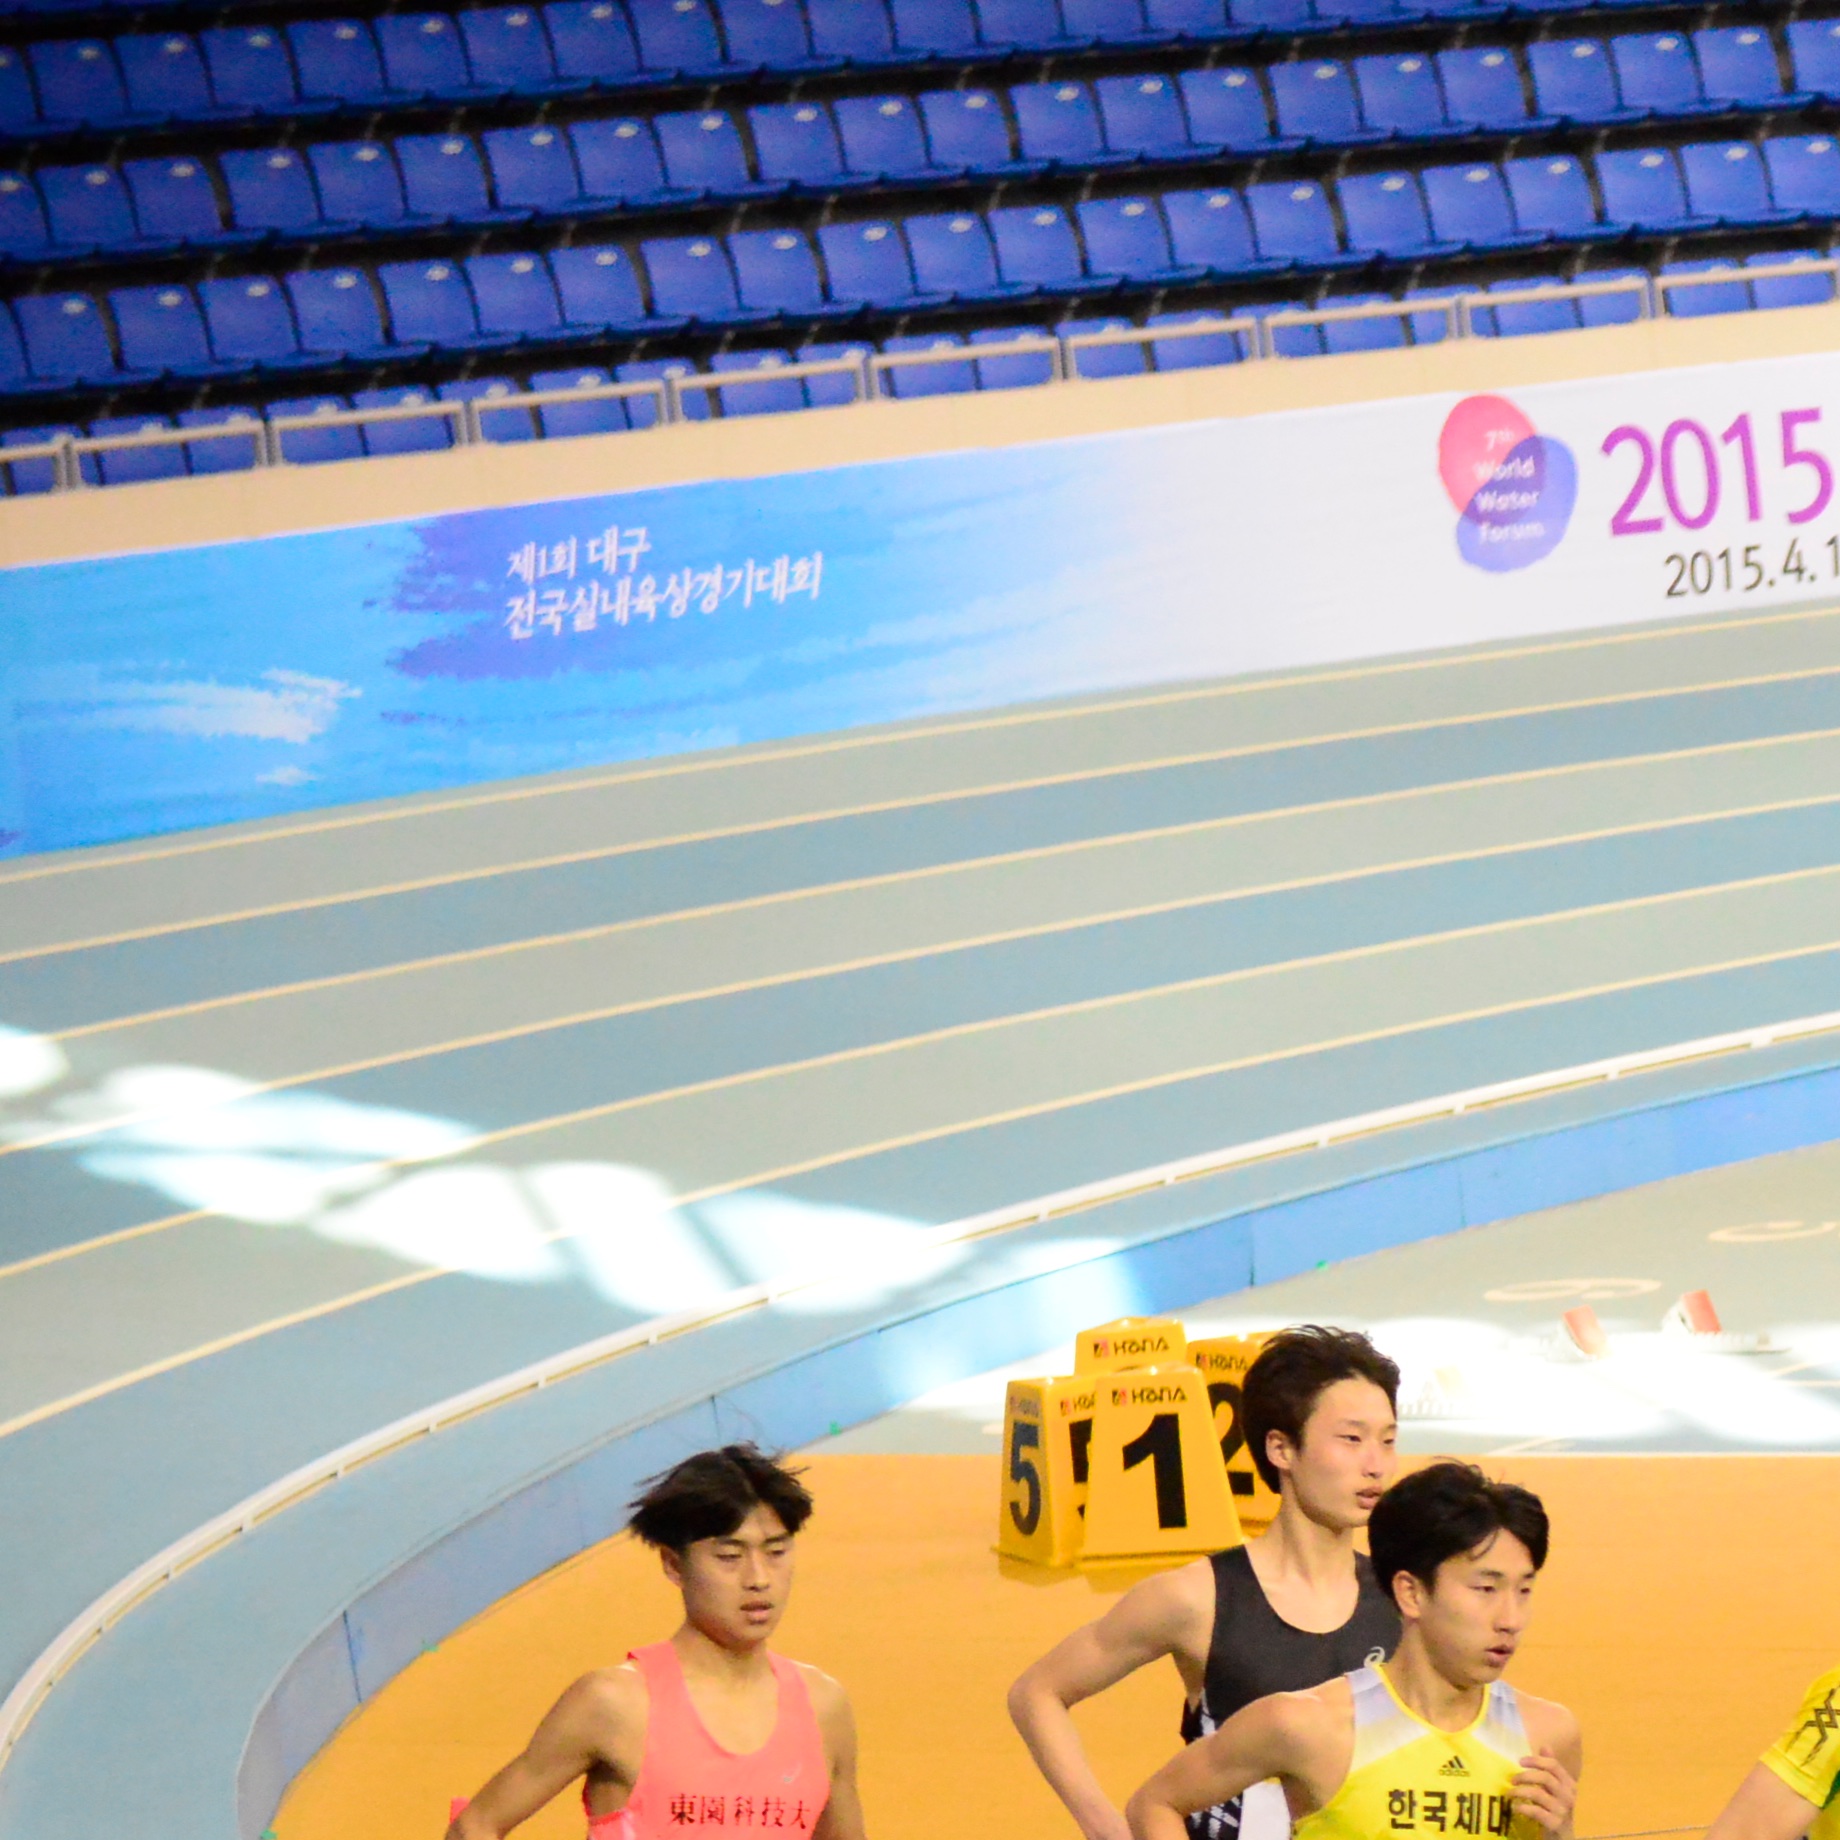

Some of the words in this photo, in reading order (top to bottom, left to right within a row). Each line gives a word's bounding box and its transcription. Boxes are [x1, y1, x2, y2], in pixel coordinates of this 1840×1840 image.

[1473, 455, 1535, 482] World
[1474, 490, 1540, 513] Water
[1600, 407, 1835, 538] 2015
[503, 551, 824, 641] 전국실내육상경기대회
[506, 536, 579, 585] 제1회
[586, 525, 652, 575] 대구
[1010, 1420, 1040, 1535] 5
[1122, 1413, 1187, 1529] 1
[1207, 1382, 1254, 1495] 2
[1388, 1789, 1513, 1837] 한국체대
